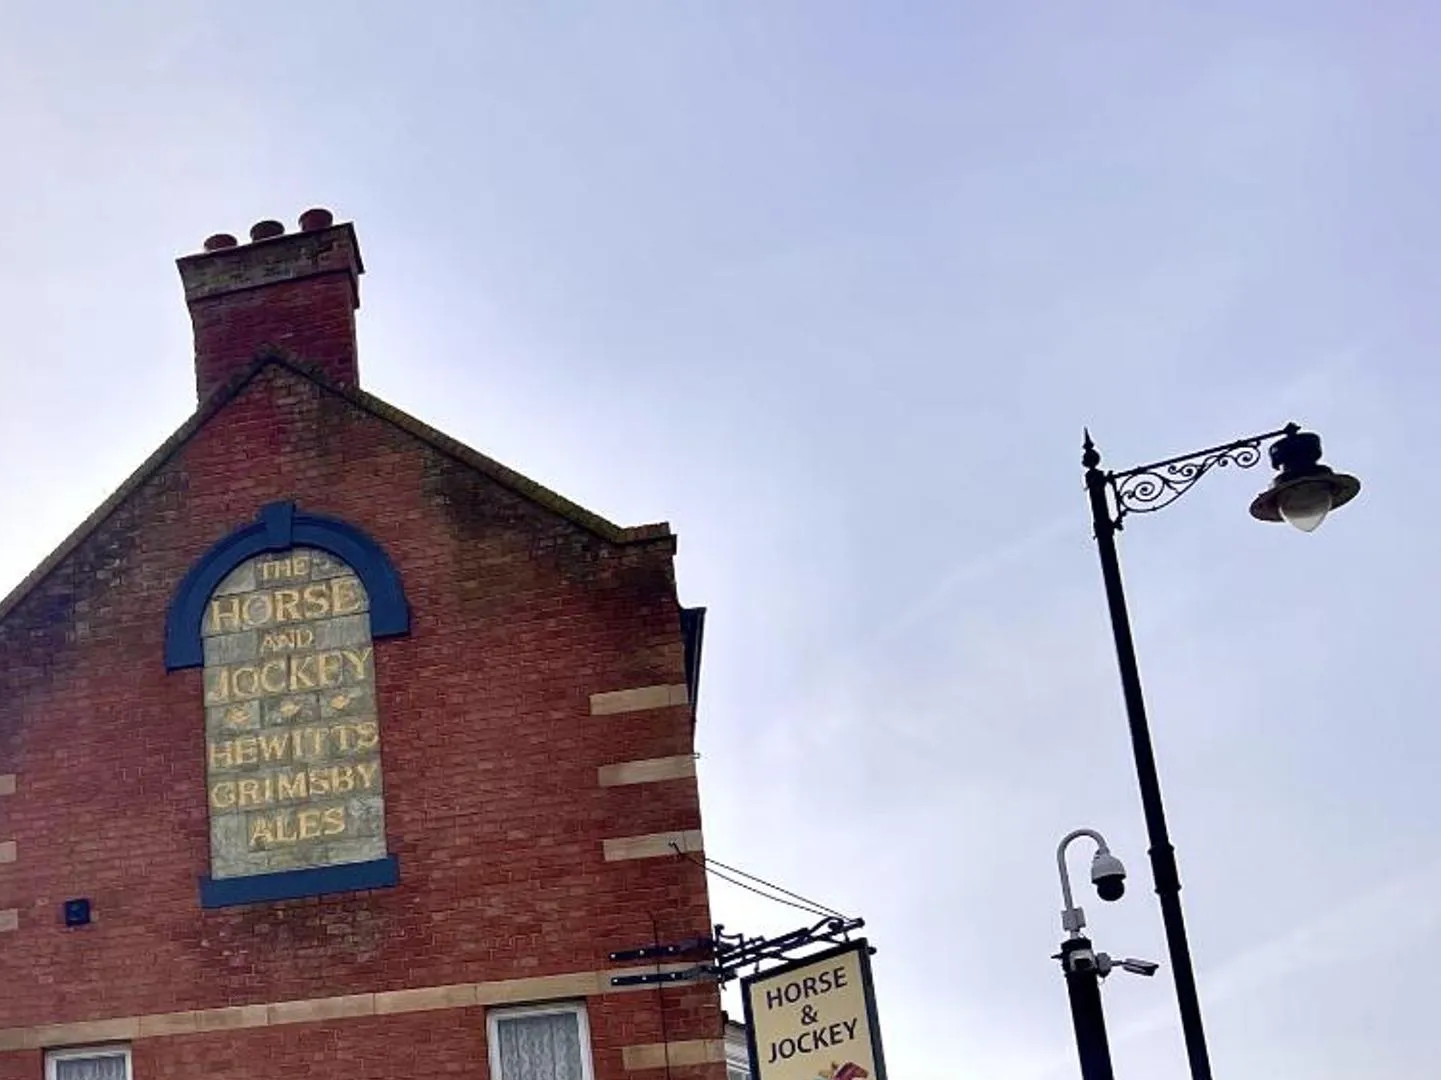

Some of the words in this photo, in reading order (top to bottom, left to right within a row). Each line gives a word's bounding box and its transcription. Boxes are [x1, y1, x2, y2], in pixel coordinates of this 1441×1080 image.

[258, 555, 310, 580] THE
[212, 580, 362, 633] HORSE
[261, 629, 313, 652] AND
[208, 646, 373, 703] JOCKEY
[210, 721, 379, 766] HEWITTS
[210, 762, 377, 808] GRIMSBY
[248, 805, 347, 847] ALES
[766, 967, 848, 1009] HORSE
[800, 1003, 819, 1026] &
[768, 1018, 858, 1064] JOCKEY
